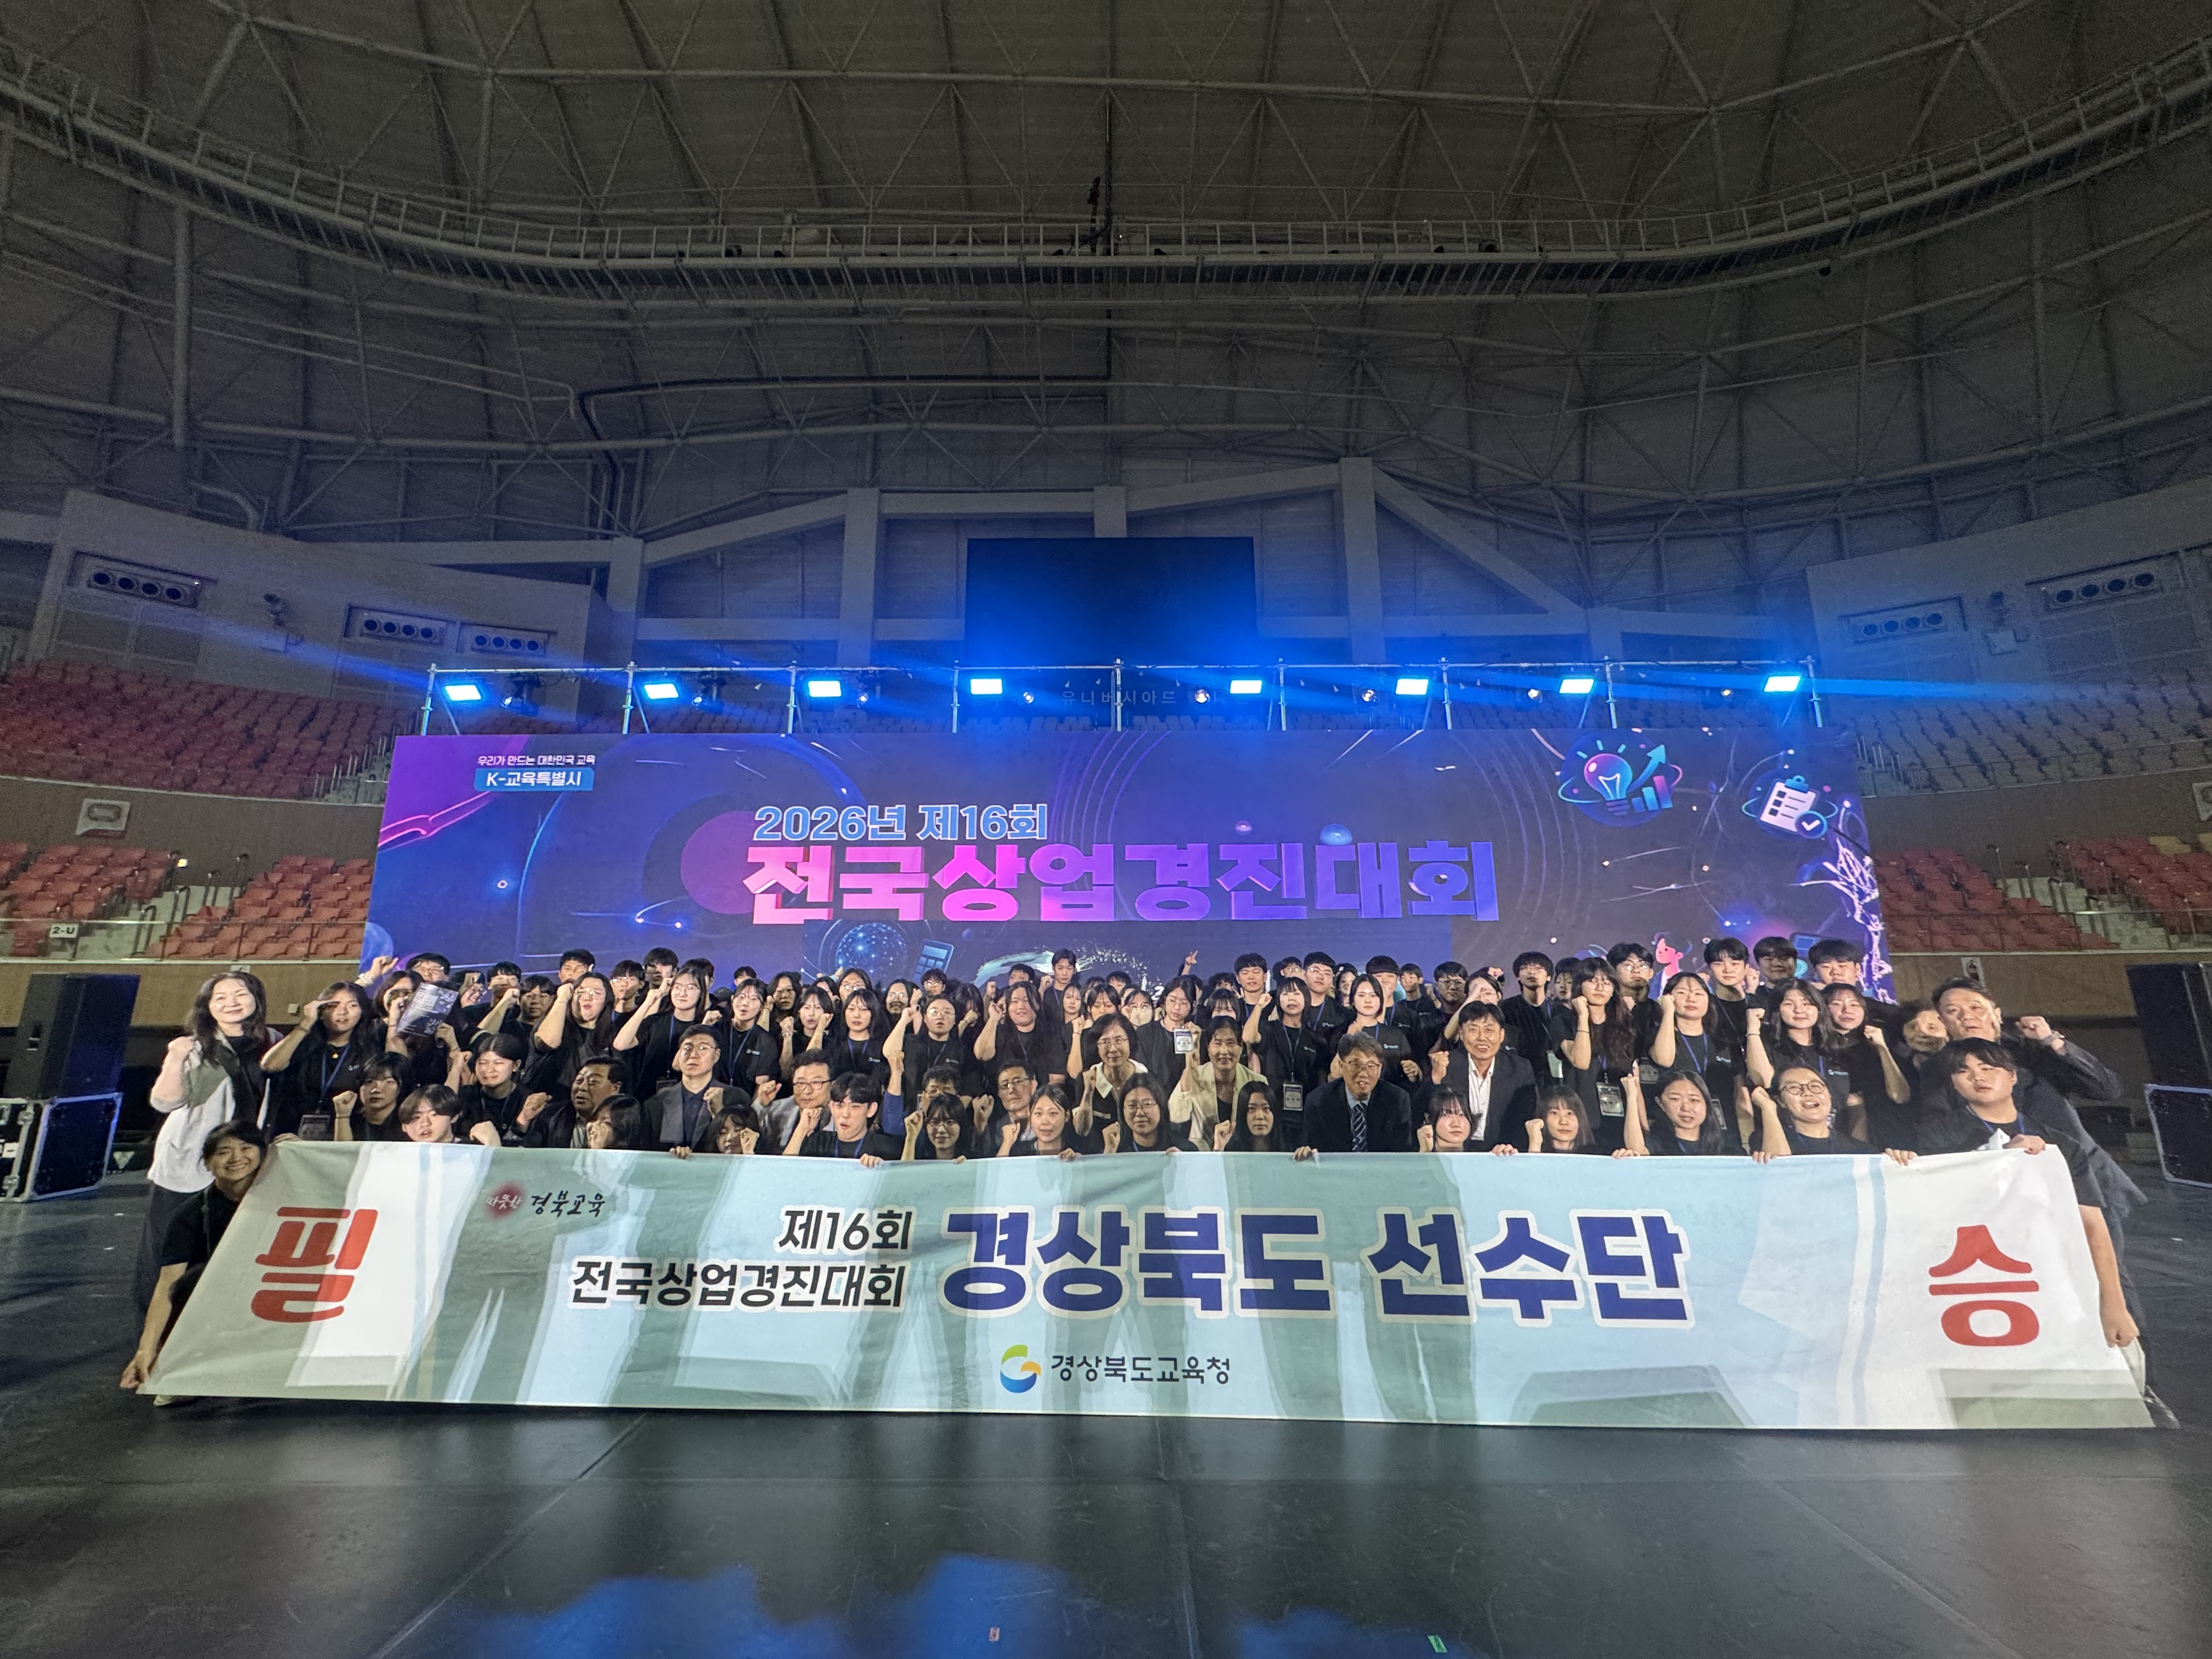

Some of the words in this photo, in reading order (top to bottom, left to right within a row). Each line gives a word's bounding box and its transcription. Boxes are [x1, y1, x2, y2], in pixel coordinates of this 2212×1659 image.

[1061, 690, 1176, 706] 유니버시아드
[477, 755, 505, 766] 우리가
[507, 755, 535, 766] 만드는
[538, 755, 575, 766] 대한민국
[577, 755, 596, 765] 교육
[486, 771, 582, 787] K-교육특별시
[753, 804, 906, 840] 2026년
[917, 804, 1048, 840] 제16회
[742, 840, 1499, 924] 전국상업경진대회
[486, 1193, 522, 1210] 따뜻한
[531, 1190, 606, 1218] 경북교육
[777, 1209, 913, 1250] 제16회
[251, 1207, 378, 1323] 필
[944, 1211, 1331, 1312] 경상북도
[1367, 1213, 1688, 1321] 선수단
[572, 1261, 906, 1308] 전국상업경진대회
[1928, 1224, 2040, 1346] 승
[1051, 1354, 1231, 1385] 경상북도교육청
